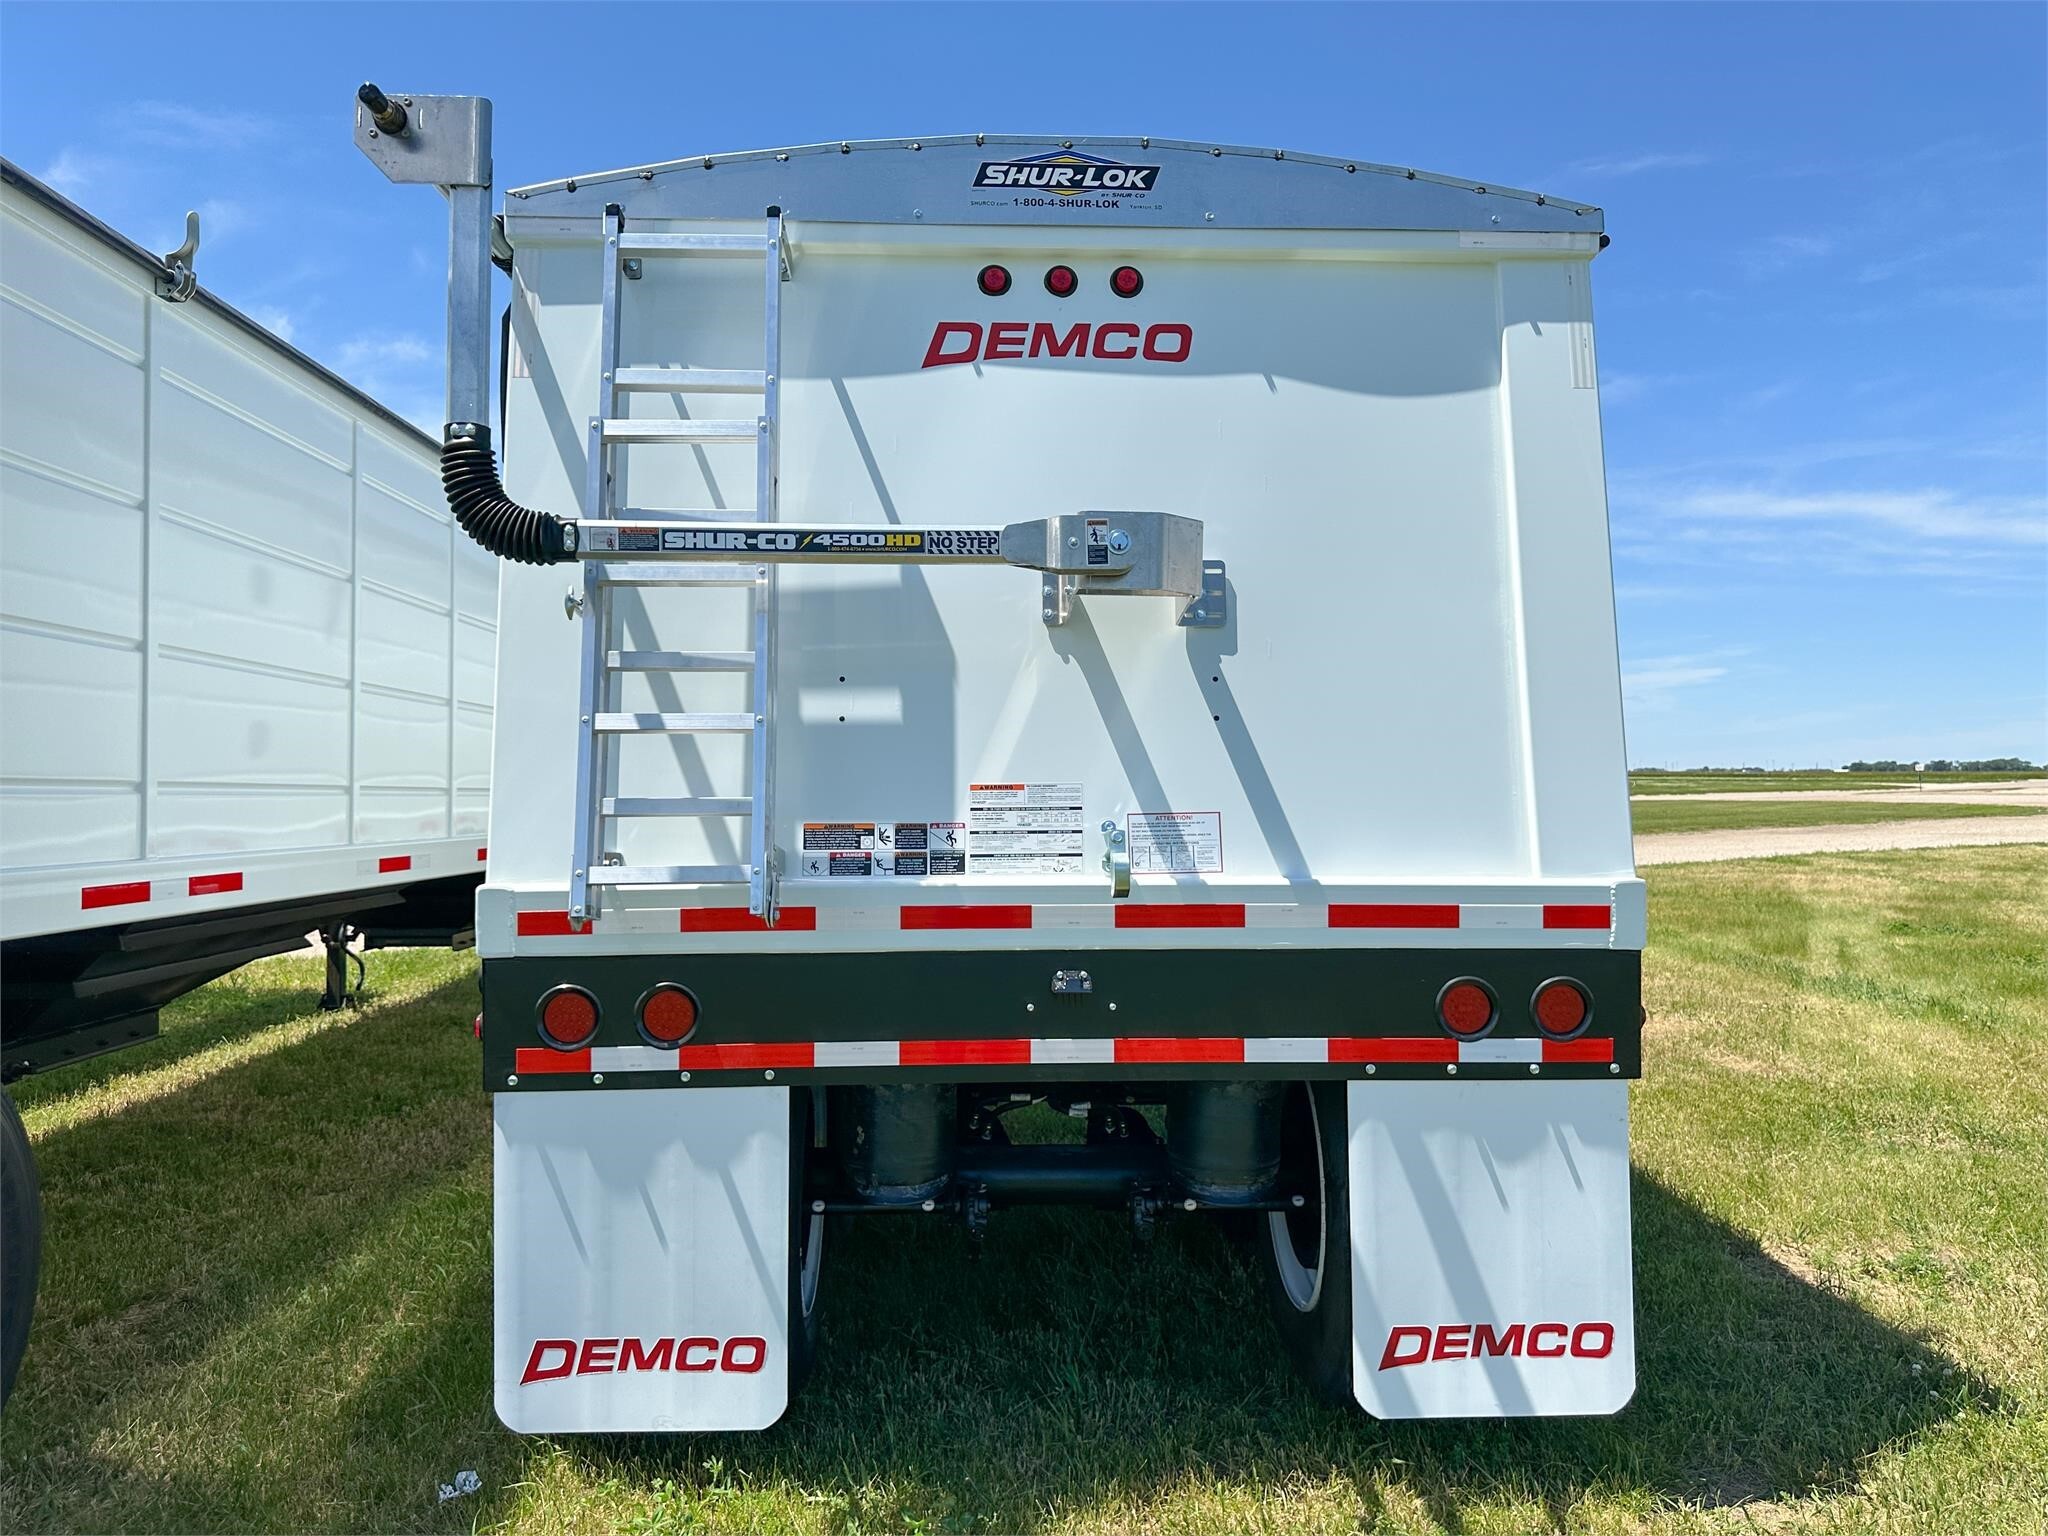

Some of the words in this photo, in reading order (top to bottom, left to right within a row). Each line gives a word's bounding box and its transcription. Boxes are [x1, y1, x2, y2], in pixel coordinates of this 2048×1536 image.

[982, 165, 1151, 188] SHUR-LOK
[1013, 198, 1120, 209] 1-800-4-SHUR-LOK
[922, 321, 1193, 369] DEMCO
[664, 531, 796, 550] SHUR-CO
[812, 534, 921, 547] 4500HD
[929, 536, 954, 549] NO
[957, 537, 998, 549] STEP
[1377, 1322, 1614, 1371] DEMCO
[519, 1336, 768, 1385] DEMCO
